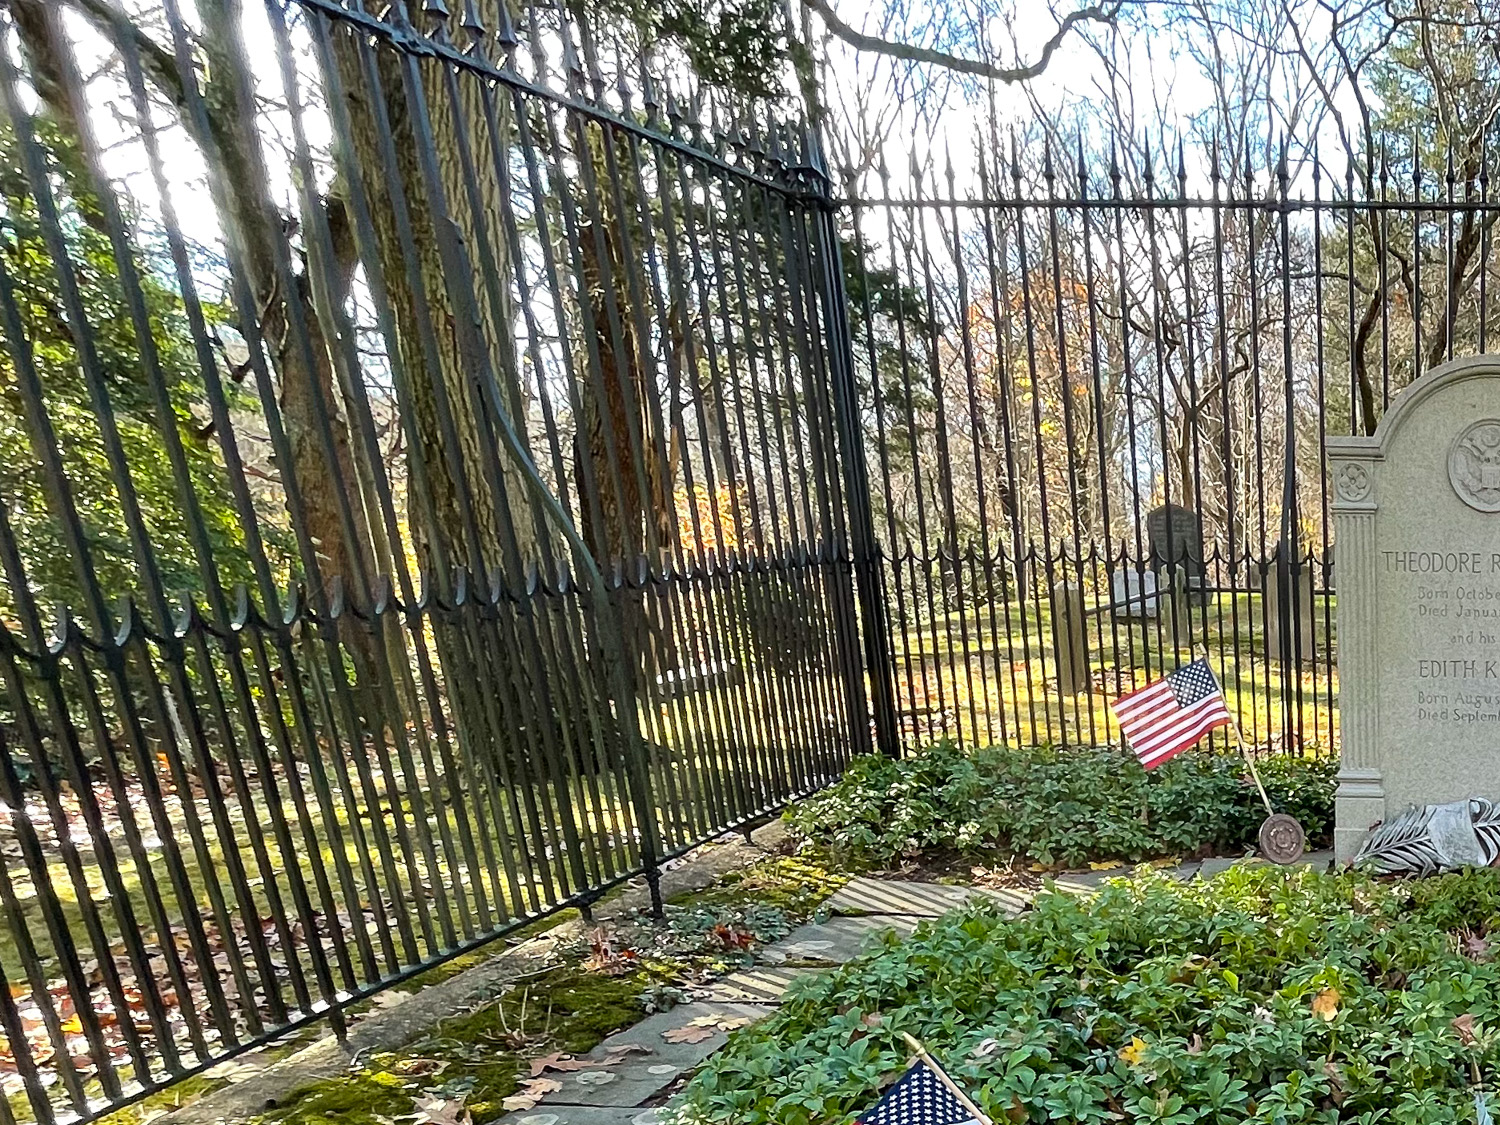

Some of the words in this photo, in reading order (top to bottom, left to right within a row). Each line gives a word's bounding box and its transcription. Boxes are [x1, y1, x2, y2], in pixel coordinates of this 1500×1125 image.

[1381, 551, 1482, 574] THEODORE
[1418, 586, 1449, 600] Born
[1418, 604, 1448, 618] Died
[1450, 630, 1474, 645] and
[1479, 631, 1496, 645] his
[1418, 659, 1476, 679] EDITH
[1418, 691, 1448, 705] Born
[1418, 708, 1449, 721] Died
